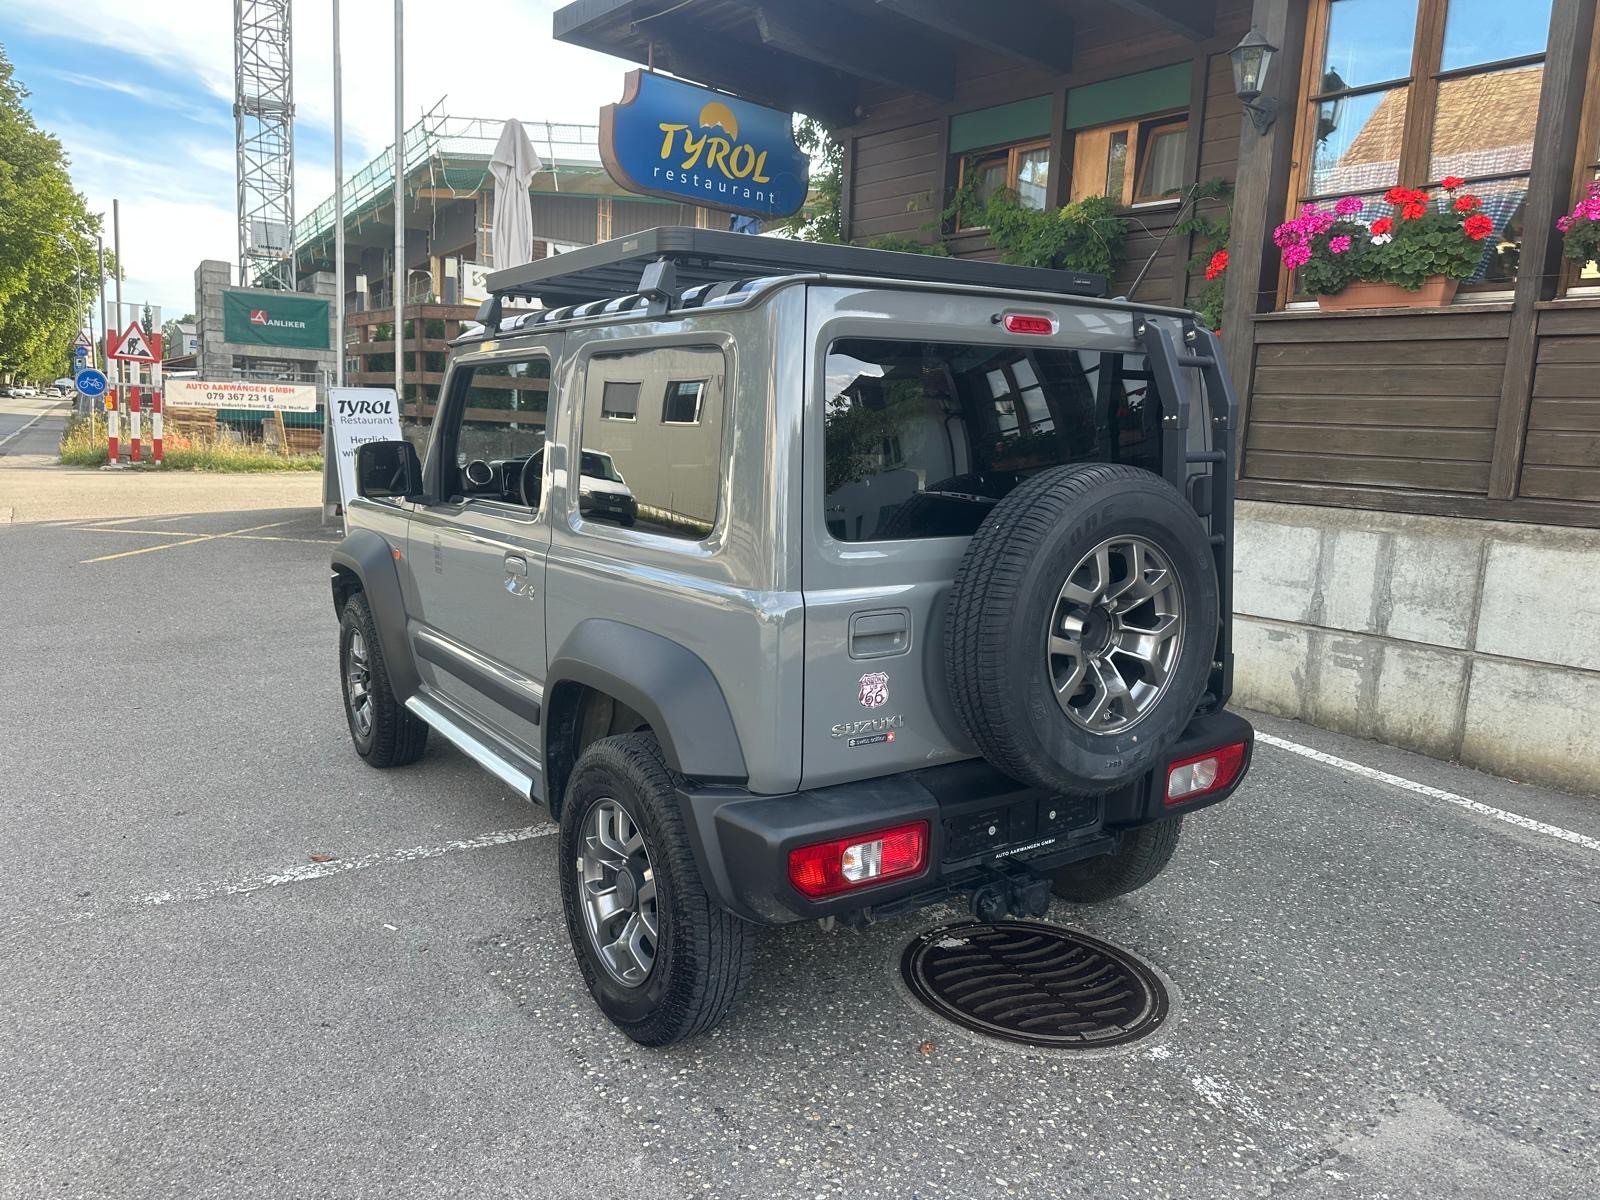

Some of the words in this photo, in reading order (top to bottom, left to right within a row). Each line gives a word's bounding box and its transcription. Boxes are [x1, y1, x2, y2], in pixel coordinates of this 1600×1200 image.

[659, 122, 770, 184] TYROL
[653, 166, 775, 204] restaurant
[266, 319, 306, 329] ANLIKER
[185, 383, 210, 391] AUTO
[212, 383, 268, 393] AARWANGEN
[269, 385, 295, 394] GMBH
[206, 392, 224, 400] 079
[227, 392, 245, 401] 367
[248, 393, 260, 401] 23
[263, 394, 274, 402] 16
[337, 399, 392, 417] TYROL
[340, 416, 394, 425] Restaurant
[865, 686, 884, 705] 66
[831, 714, 903, 737] SUZUKI
[995, 850, 1010, 859] AUTO
[1009, 842, 1041, 855] AARWANGEN
